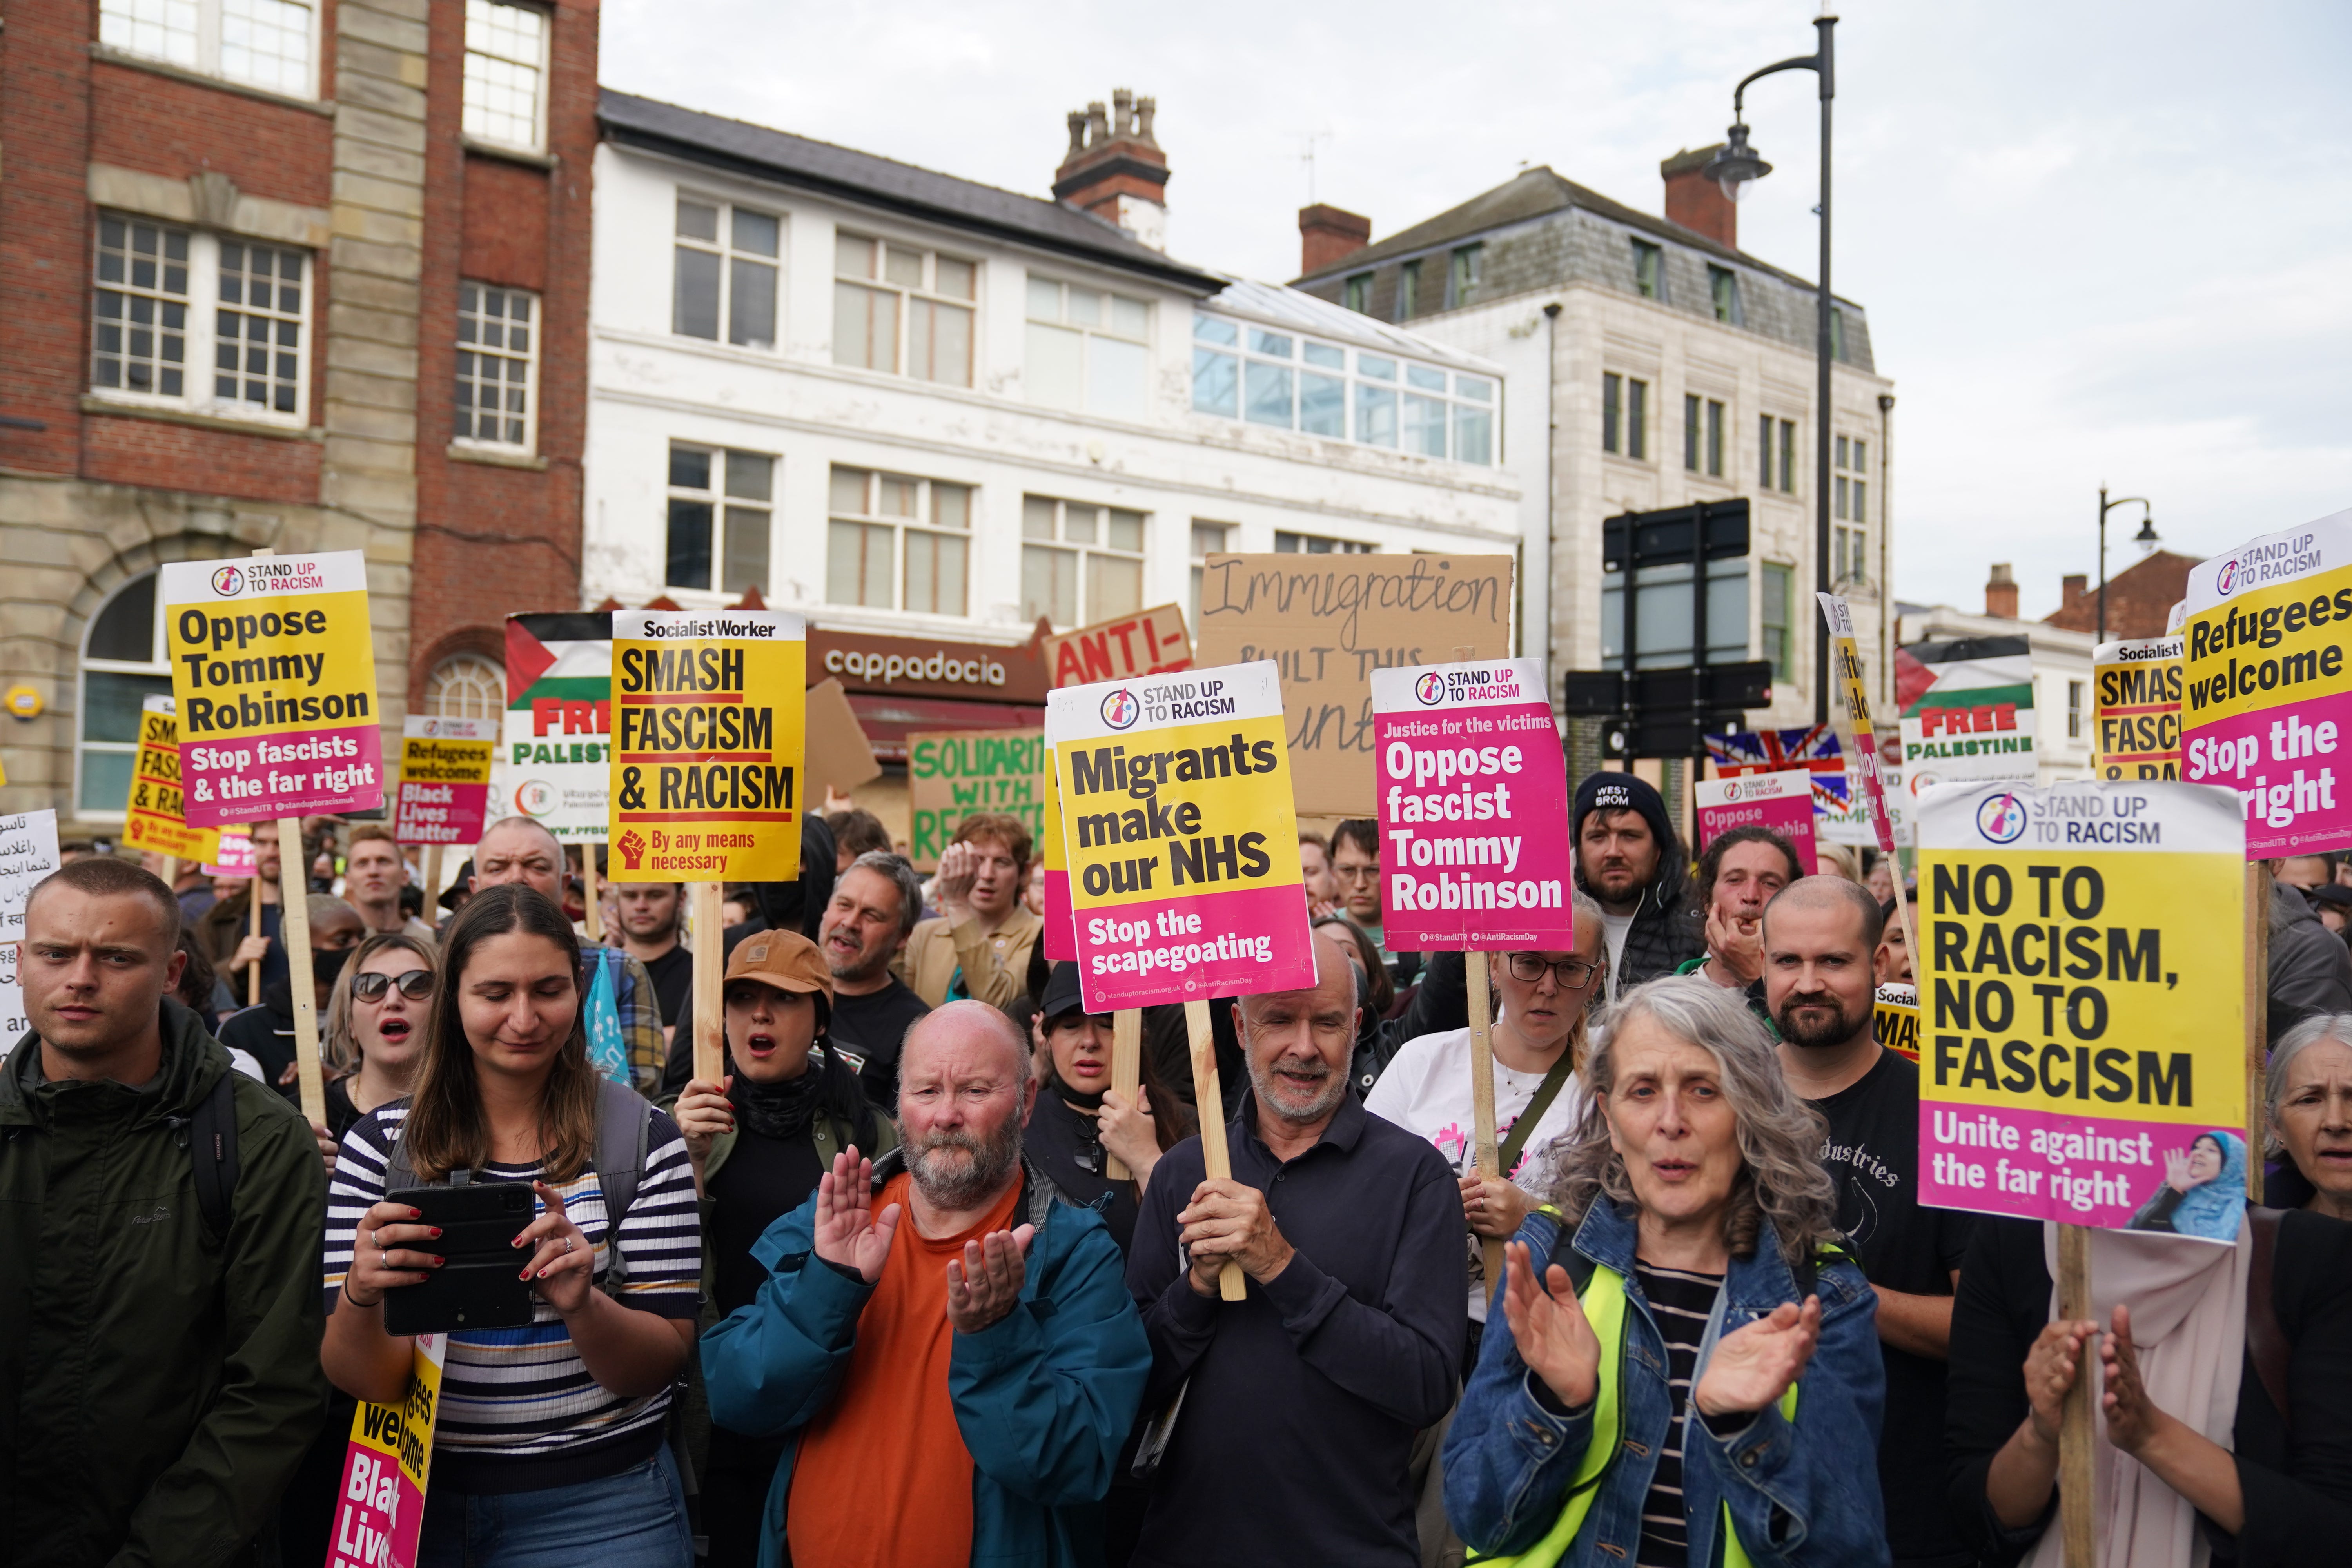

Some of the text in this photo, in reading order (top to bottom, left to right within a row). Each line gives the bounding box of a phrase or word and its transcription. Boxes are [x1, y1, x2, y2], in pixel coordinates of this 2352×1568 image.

[2240, 550, 2321, 588] TO RACISM
[2241, 534, 2314, 568] STAND UP
[248, 563, 315, 579] STAND UP
[249, 575, 323, 592] TO RACISM
[1204, 558, 1497, 651] Immigration
[179, 609, 326, 651] Oppose
[644, 620, 776, 637] Socialist Worker
[2190, 586, 2352, 662] Refugees
[182, 652, 324, 688] Tommy
[621, 648, 744, 692] SMASH
[824, 649, 1006, 686] cappadocia
[1056, 617, 1180, 689] ANTI-
[2119, 644, 2178, 661] Socialist
[1143, 680, 1223, 704] STAND UP
[1448, 669, 1513, 686] STAND UP
[1449, 684, 1519, 702] TO RACISM
[2101, 666, 2182, 706] SMAS
[2189, 644, 2343, 711] welcome
[187, 691, 368, 732] Robinson
[532, 698, 610, 737] FRE
[621, 706, 772, 750] FASCISM
[1146, 697, 1235, 723] TO RACISM
[1383, 713, 1551, 739] Justice for the victims
[1920, 702, 2016, 738] FREE
[1907, 736, 2033, 760] PALESTINE
[2102, 714, 2181, 753] FASCI
[2189, 734, 2259, 780] Stop
[2269, 715, 2338, 756] the
[141, 751, 181, 780] FASC
[191, 735, 358, 772] Stop fascists
[406, 763, 482, 779] welcome
[408, 742, 487, 763] Refugees
[513, 743, 610, 764] PALEST
[914, 734, 1044, 779] SOLIDARIT
[1071, 733, 1277, 799] Migrants
[1386, 741, 1522, 788] Oppose
[194, 763, 375, 802] & the far right
[401, 783, 454, 804] Black
[619, 766, 793, 810] & RACISM
[952, 779, 1032, 805] WITH
[1595, 795, 1628, 806] BROM
[1597, 786, 1628, 796] WEST
[1755, 787, 1782, 796] RACISM
[2239, 767, 2335, 829] right
[400, 804, 448, 822] Lives
[1077, 794, 1201, 848] make
[1387, 783, 1511, 823] fascist
[1705, 808, 1762, 828] Oppose
[2034, 795, 2147, 818] STAND UP
[397, 822, 461, 842] Matter
[652, 830, 755, 852] By any means
[2034, 821, 2160, 844] TO RACISM
[652, 855, 728, 873] necessary
[1082, 831, 1270, 897] our NHS
[1388, 829, 1522, 873] Tommy
[1391, 872, 1562, 911] Robinson
[1933, 864, 2104, 920] NO TO
[1088, 909, 1201, 946] Stop the
[1428, 932, 1537, 943] @StandUTR @AntiRacismDay
[1092, 933, 1273, 976] scapegoating
[1934, 920, 2179, 991] RACISM,
[1107, 977, 1252, 999] standuptoracism.org.uk @AntiRacismDay
[1878, 988, 1919, 1007] Social
[1934, 978, 2108, 1040] NO TO
[1935, 1036, 2193, 1108] FASCISM
[1933, 1110, 2153, 1166] Unite against
[1819, 1136, 1900, 1187] dustries
[1933, 1154, 2131, 1212] the far right
[417, 1334, 433, 1350] ACISM
[408, 1372, 433, 1425] gees
[363, 1403, 424, 1479] welome
